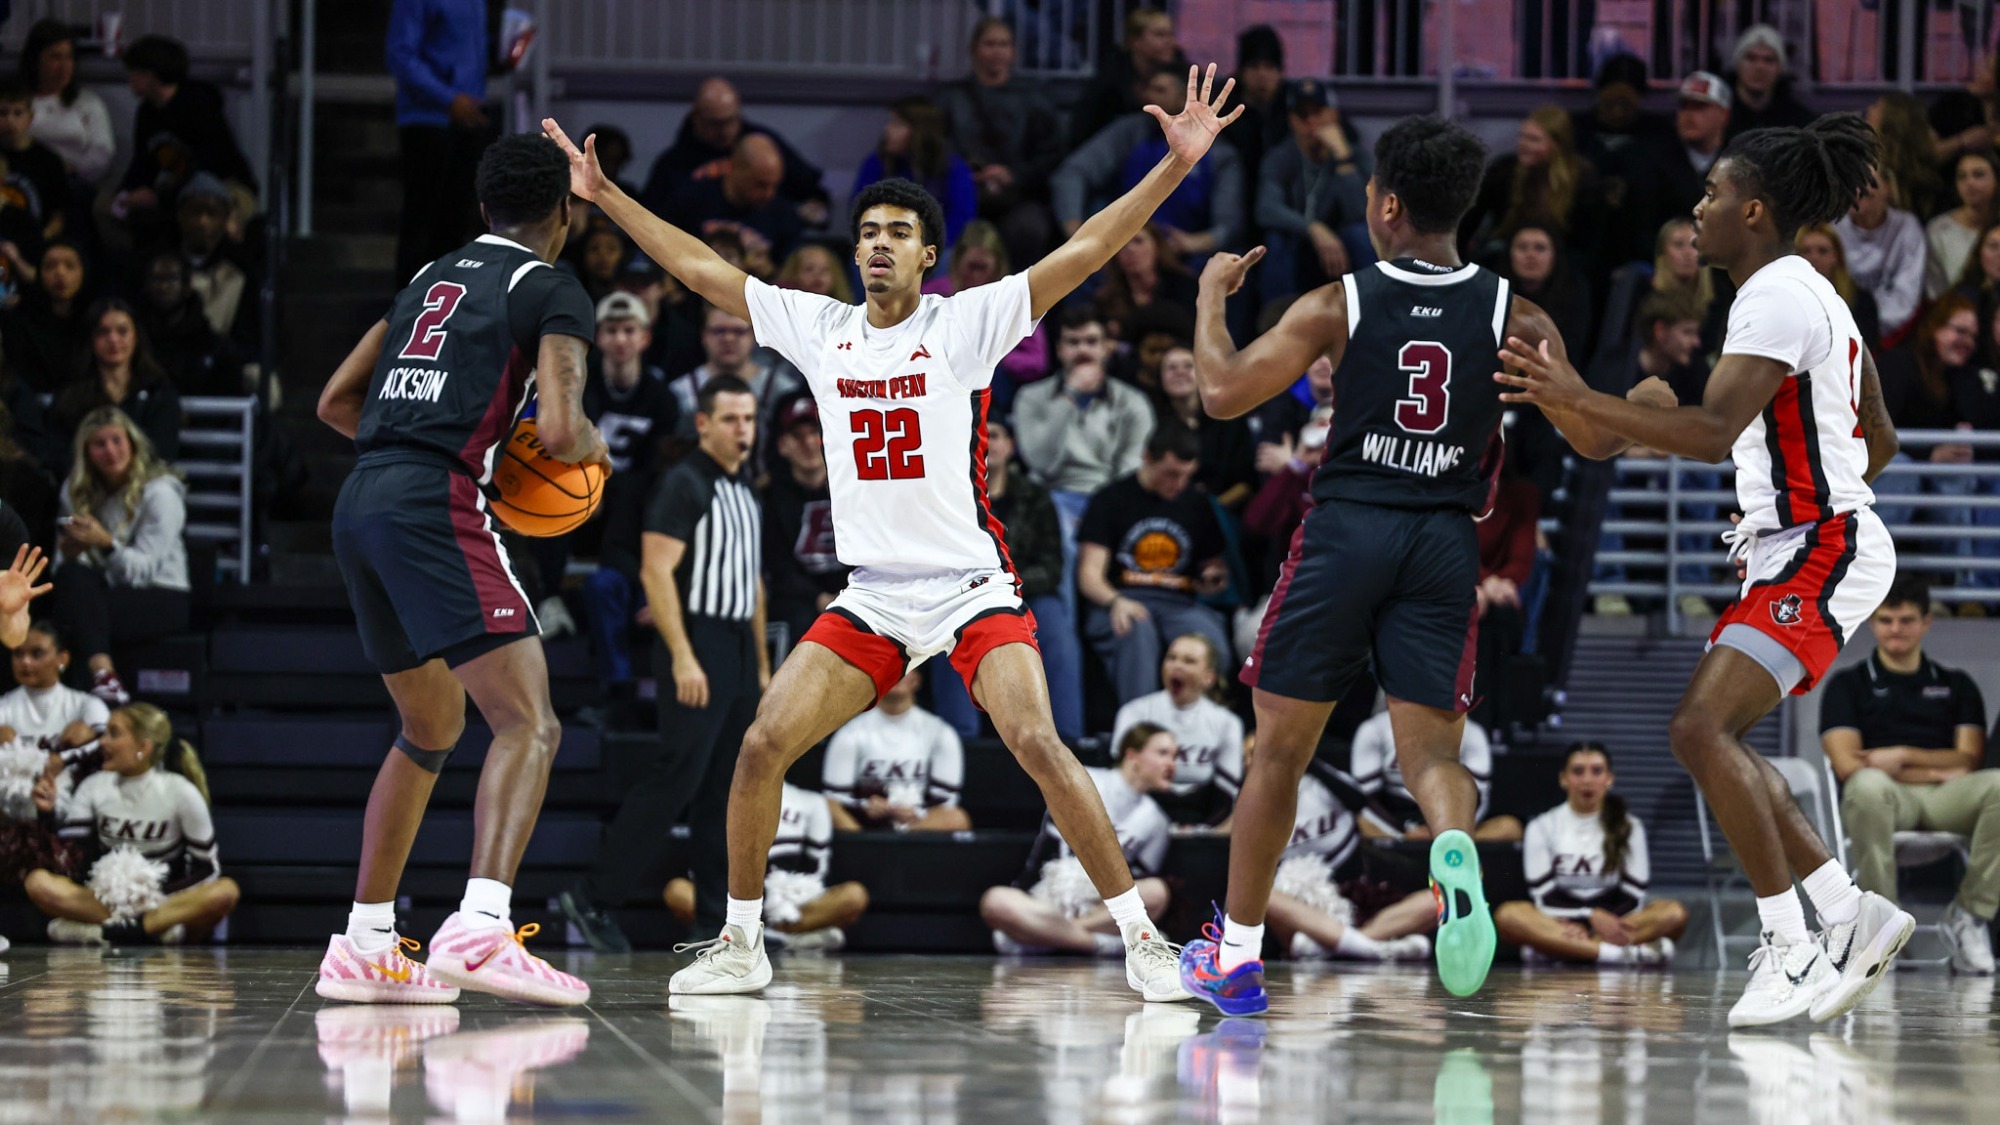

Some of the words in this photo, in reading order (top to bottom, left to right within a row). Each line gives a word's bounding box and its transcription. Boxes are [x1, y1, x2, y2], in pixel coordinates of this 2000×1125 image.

[1413, 258, 1435, 270] NIKE
[1434, 265, 1454, 273] PRO
[398, 280, 468, 362] 2
[1410, 305, 1443, 317] EKU
[888, 372, 927, 399] PEAY
[1393, 340, 1453, 435] 3
[849, 407, 925, 480] 22
[1361, 431, 1465, 478] WILLIAMS
[492, 607, 516, 618] EKU
[101, 814, 170, 840] EKU
